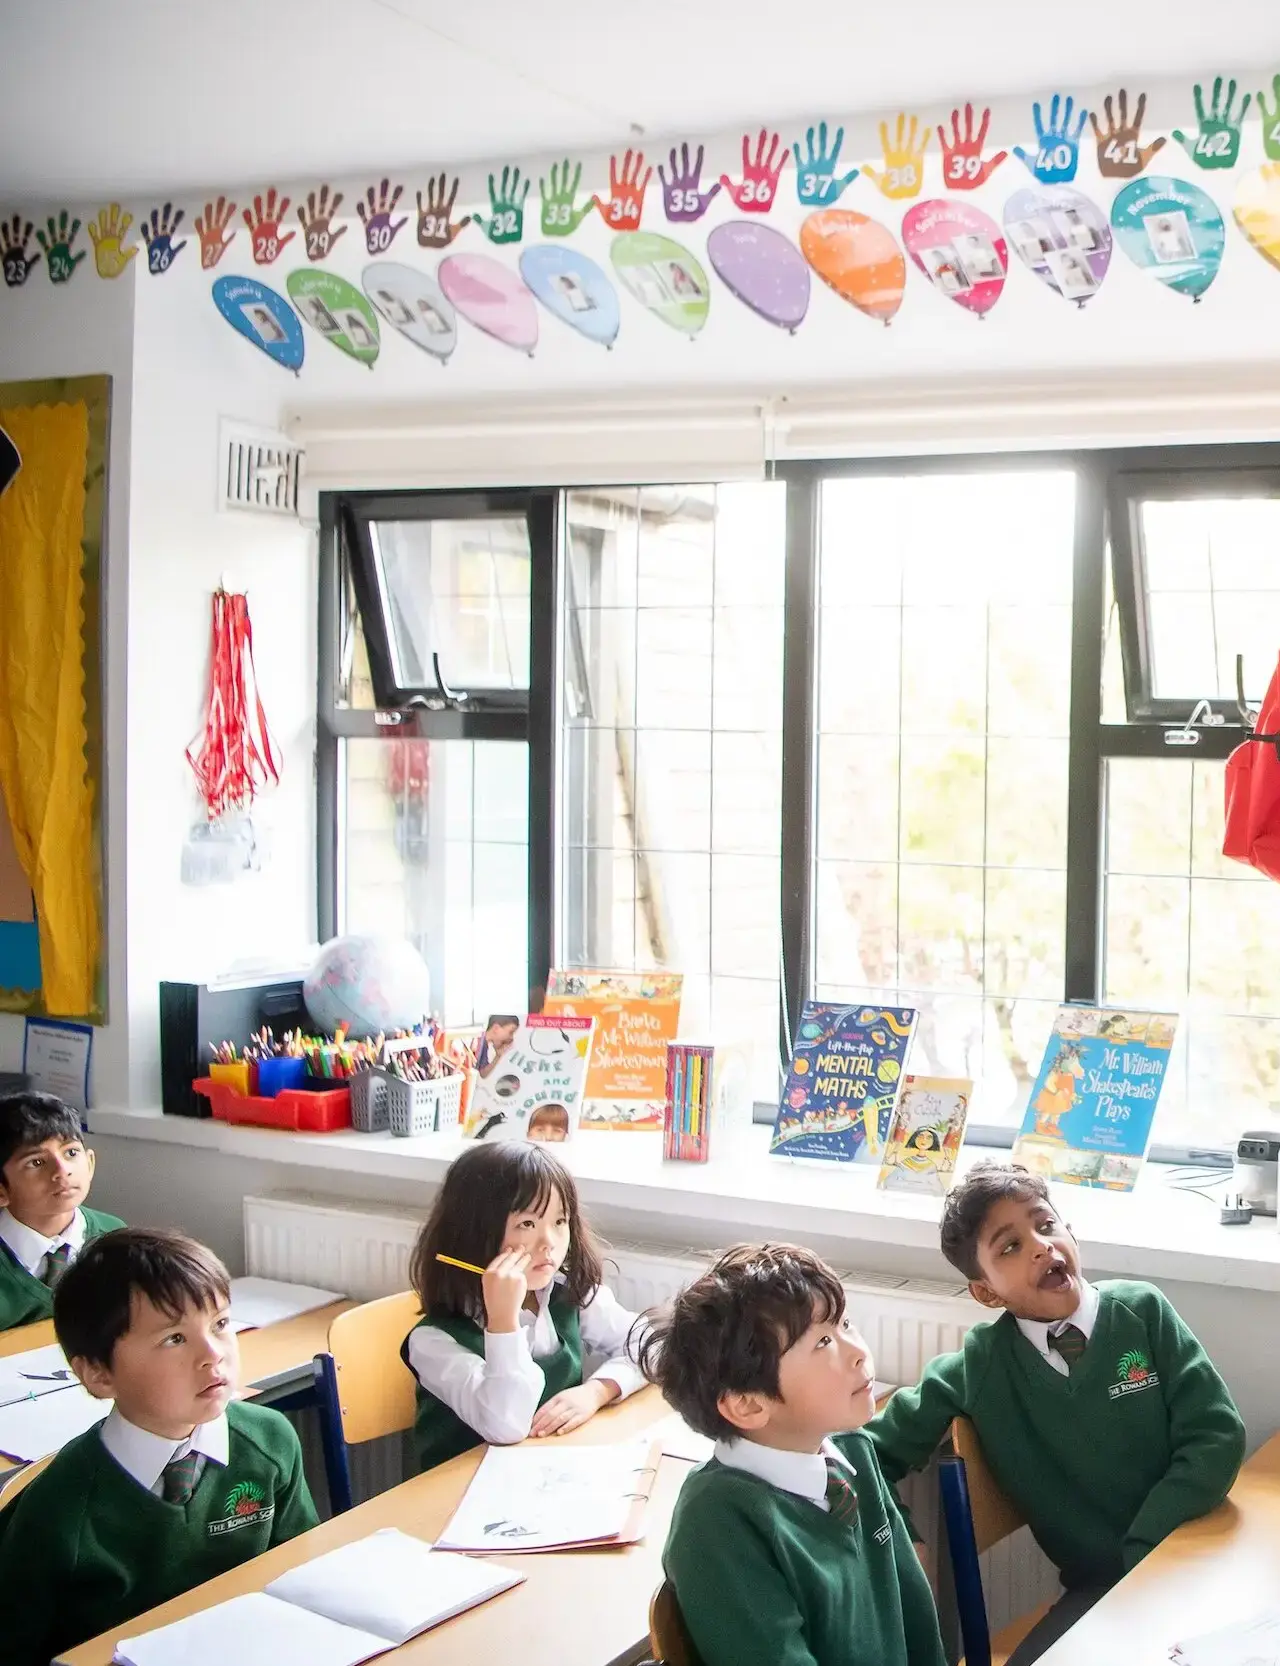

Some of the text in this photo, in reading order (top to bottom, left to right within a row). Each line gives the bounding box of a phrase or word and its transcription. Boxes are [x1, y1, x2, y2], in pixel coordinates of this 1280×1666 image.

[1103, 138, 1138, 165] 41
[1196, 130, 1232, 159] 42
[948, 155, 982, 181] 39
[1036, 145, 1072, 172] 40
[801, 173, 833, 199] 37
[886, 165, 917, 189] 38
[669, 189, 700, 213] 35
[740, 179, 772, 203] 36
[545, 203, 571, 225] 33
[610, 197, 638, 221] 34
[422, 215, 448, 239] 31
[491, 211, 518, 236] 32
[256, 238, 277, 260] 28
[309, 233, 330, 255] 29
[369, 226, 391, 250] 30
[151, 251, 170, 270] 26
[204, 245, 223, 266] 27
[7, 262, 26, 282] 23
[52, 257, 70, 279] 24
[508, 1050, 563, 1074] light
[816, 1053, 876, 1077] MENTAL
[1098, 1047, 1163, 1076] Mr. William
[543, 1076, 572, 1086] and
[814, 1076, 868, 1100] MATHS
[1082, 1068, 1157, 1100] Shakespeare's
[515, 1089, 579, 1119] sound
[1093, 1094, 1131, 1123] Plays
[207, 1524, 226, 1533] THE
[874, 1526, 891, 1542] THE
